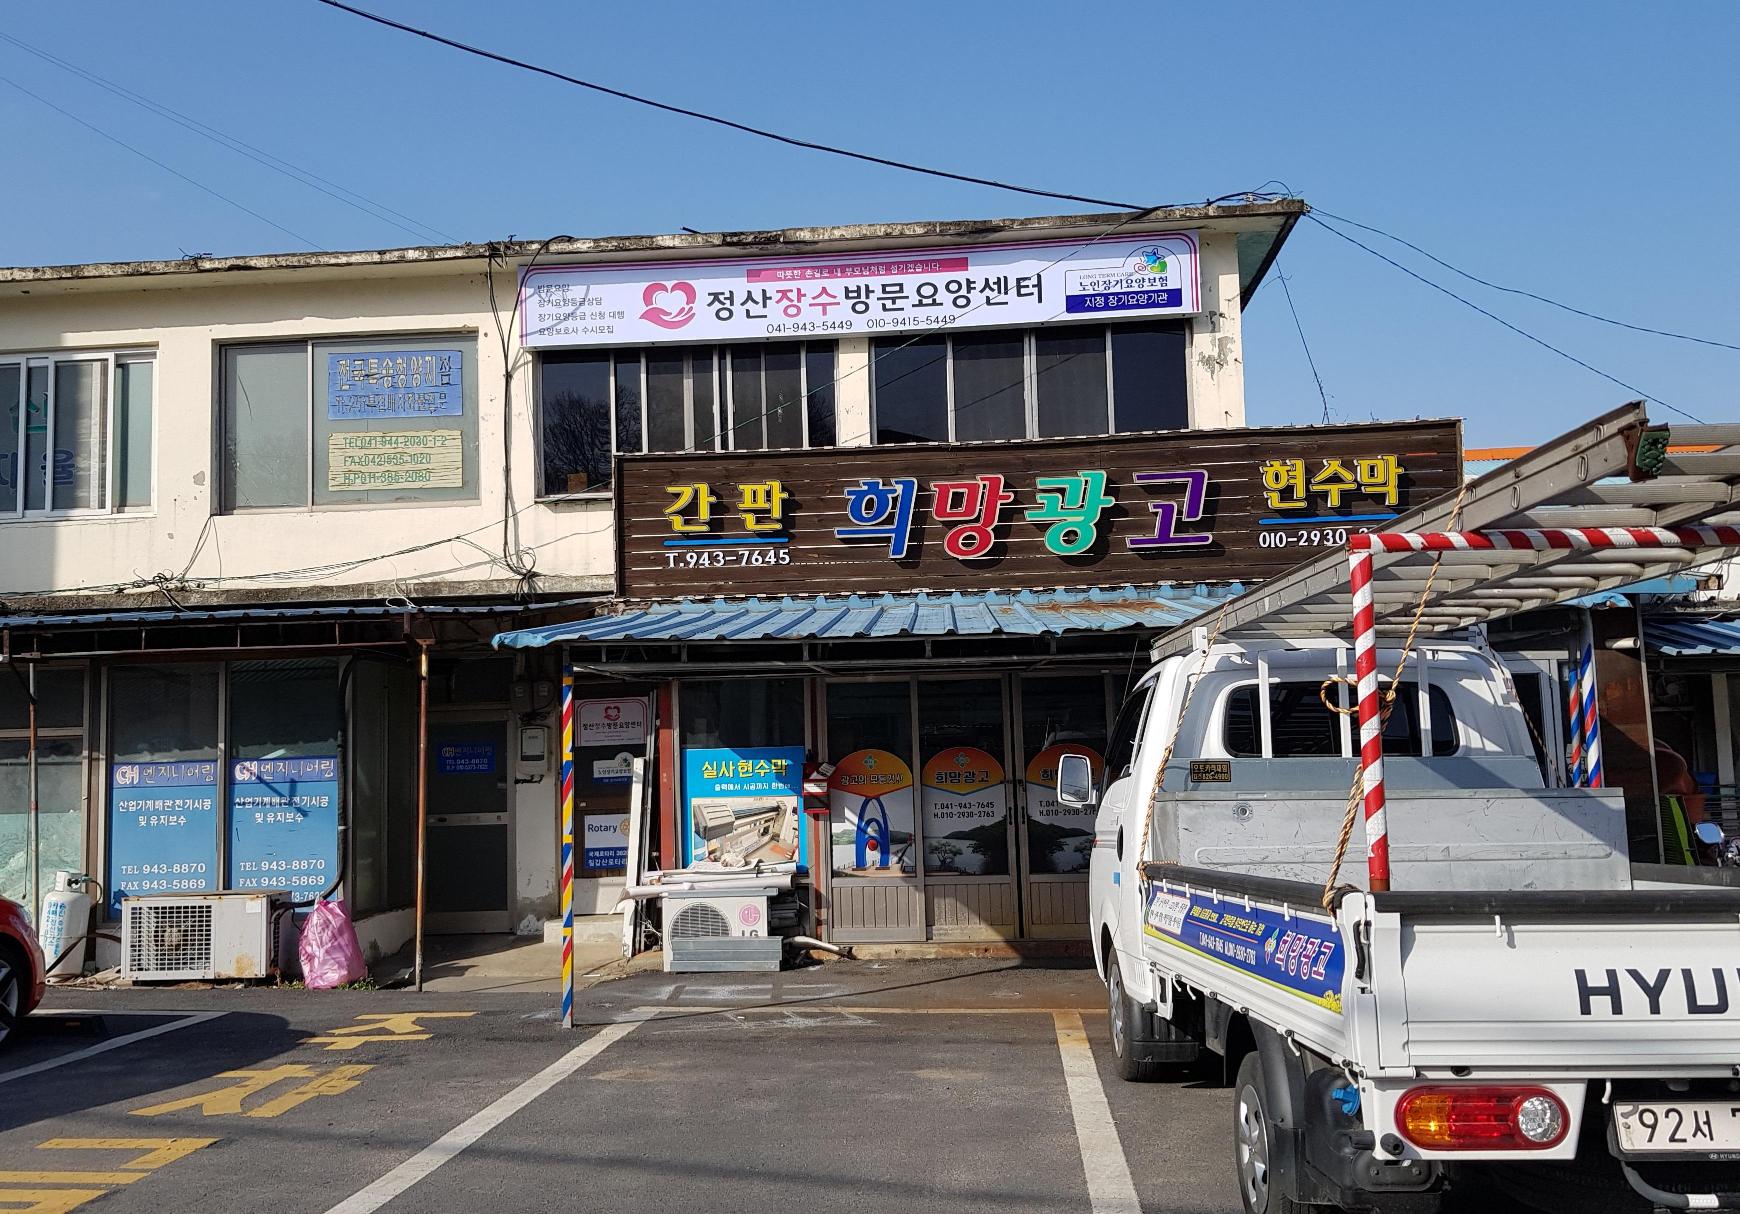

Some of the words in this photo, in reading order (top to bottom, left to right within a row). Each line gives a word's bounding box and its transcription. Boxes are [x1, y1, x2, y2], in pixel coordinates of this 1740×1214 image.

[1078, 276, 1168, 292] 노인장기요양보험
[706, 273, 1043, 323] 정산장수방문요양센터
[1084, 296, 1105, 308] 지정
[1107, 292, 1168, 306] 장기요양기관
[590, 311, 606, 320] 신청
[582, 325, 614, 336] 수시모집
[766, 320, 853, 334] 041-943-5449
[866, 315, 956, 329] 010-9415-5449
[1258, 454, 1405, 509] 현수막
[665, 549, 791, 569] T.943-7645
[935, 770, 990, 785] 희망광고
[934, 801, 995, 810] T.041-943-7645
[255, 812, 264, 824] 및
[267, 812, 304, 824] 유지보수
[933, 810, 995, 819] H.010-2930-2763
[138, 816, 148, 827] 및
[150, 815, 187, 827] 유지보수
[587, 824, 618, 834] Rotary
[121, 865, 138, 874] TEL
[142, 863, 206, 874] 943-8870
[240, 862, 258, 871] TEL
[260, 860, 326, 871] 943-8870
[120, 881, 140, 890] FAX
[142, 879, 206, 890] 943-5869
[239, 878, 258, 887] FAX
[260, 876, 326, 887] 943-5869
[1275, 929, 1336, 980] 희망광고
[1574, 968, 1740, 1016] HYU
[1638, 1108, 1714, 1143] 92서
